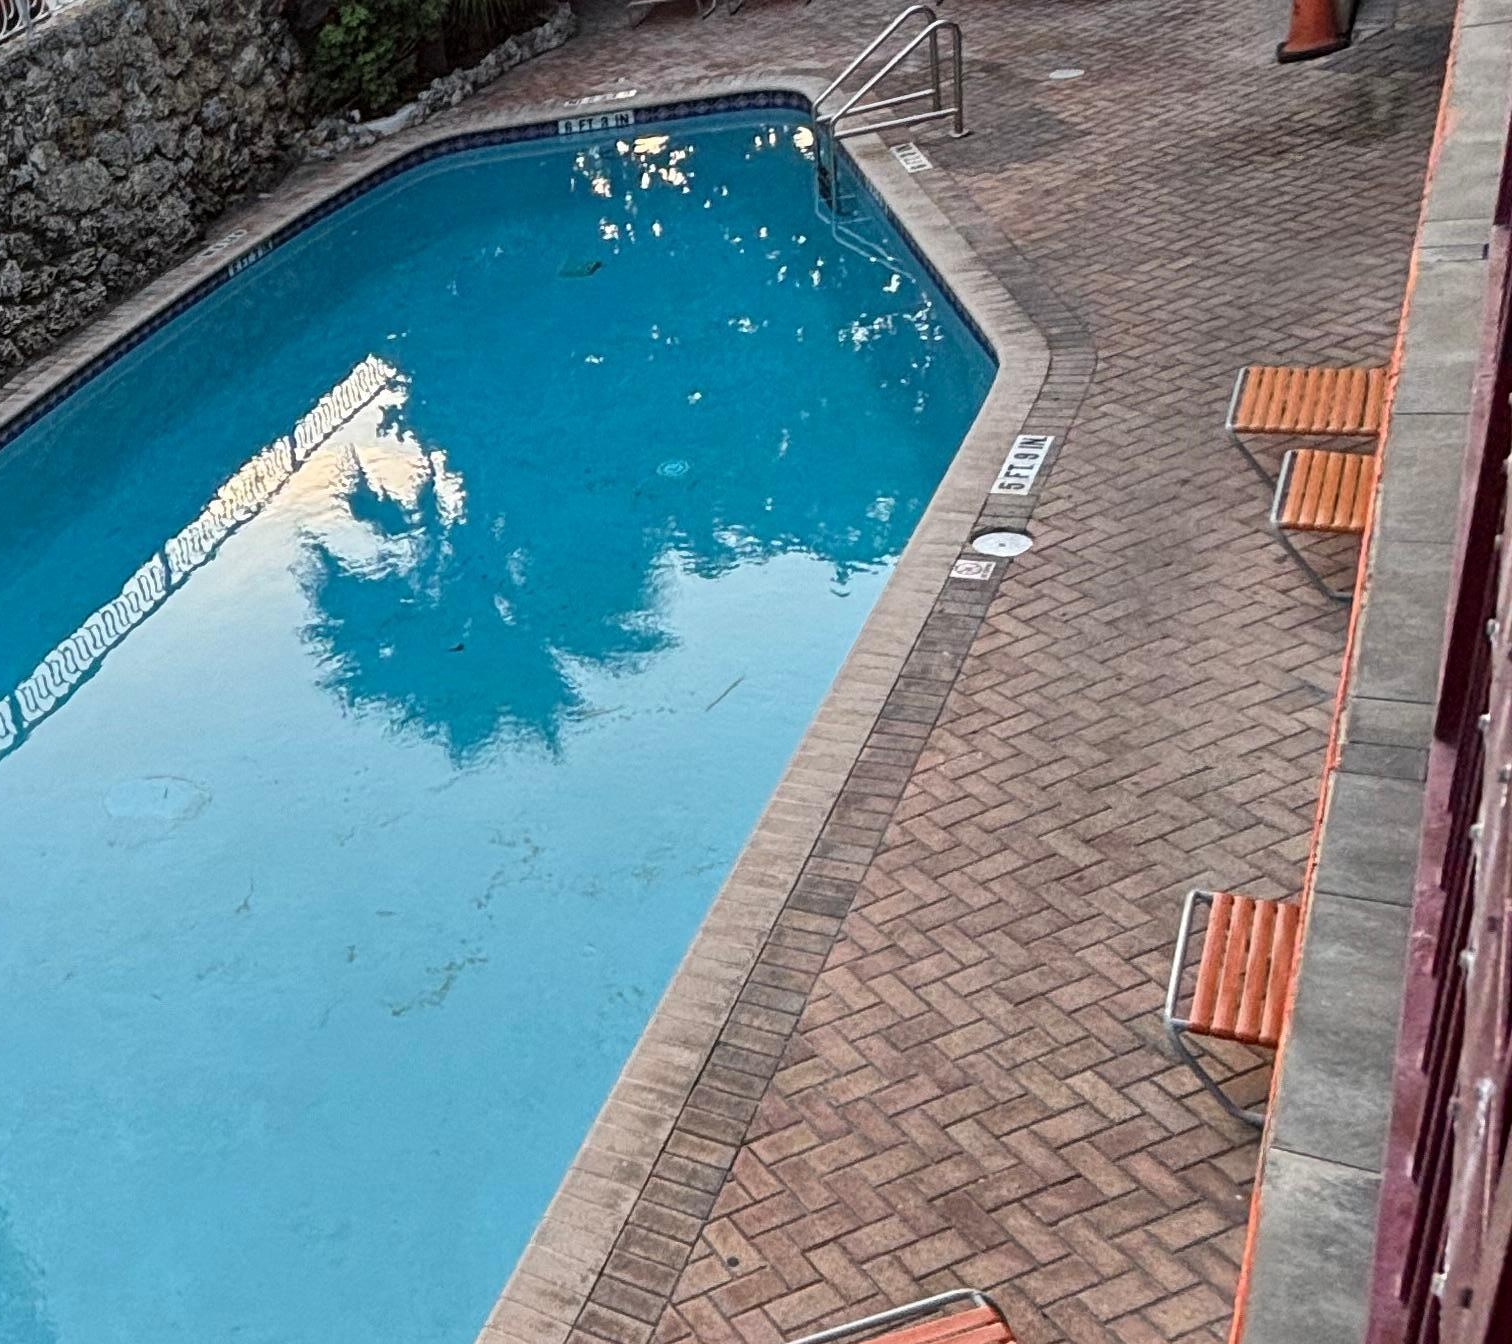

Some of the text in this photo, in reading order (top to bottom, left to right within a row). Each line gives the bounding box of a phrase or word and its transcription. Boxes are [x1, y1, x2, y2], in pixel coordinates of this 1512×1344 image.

[578, 117, 594, 131] FT
[615, 113, 629, 126] IN
[998, 482, 1025, 490] 5
[1013, 453, 1039, 461] 9
